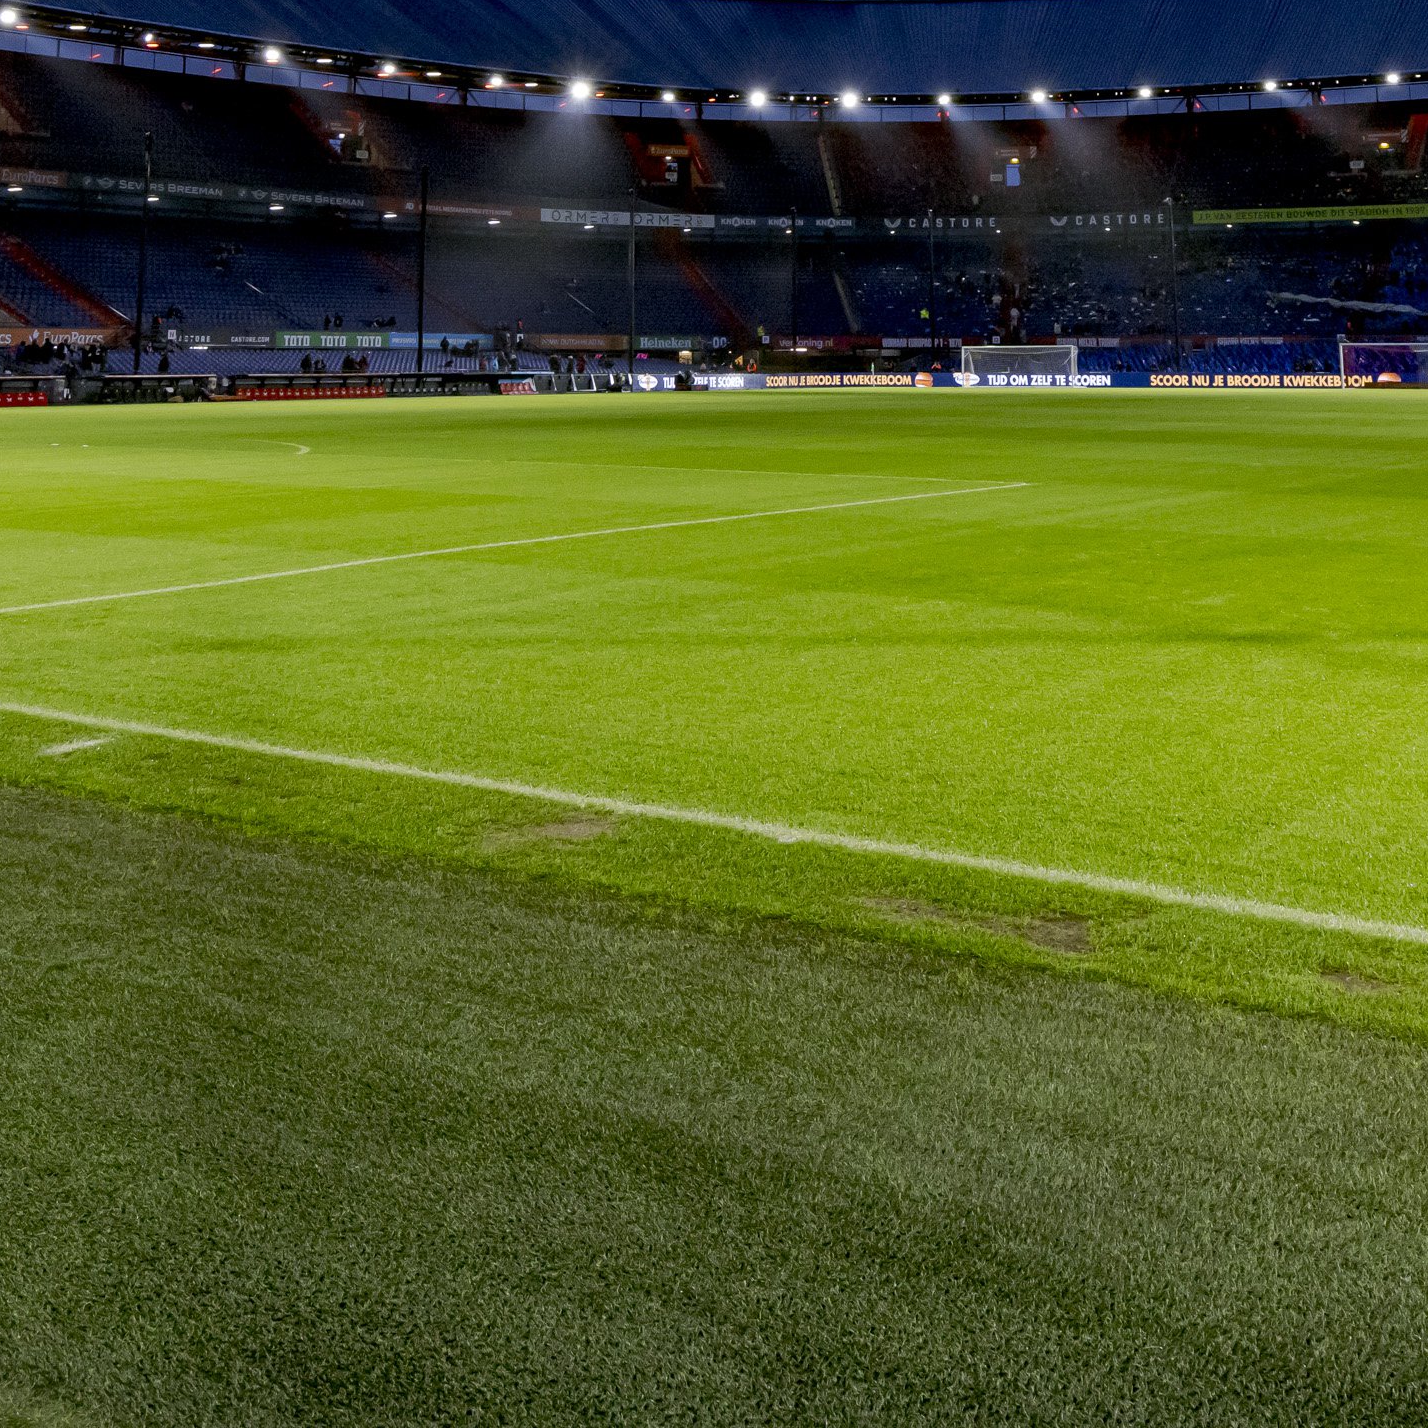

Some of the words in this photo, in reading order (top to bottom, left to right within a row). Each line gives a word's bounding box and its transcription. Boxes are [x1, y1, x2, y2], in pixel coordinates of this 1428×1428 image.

[118, 179, 165, 193] SEVRS
[909, 217, 996, 228] CASTORE
[1075, 213, 1164, 226] CASTORE
[230, 335, 270, 343] CASTORE.COM
[284, 335, 310, 346] TOTO
[320, 335, 347, 347] TOTO
[356, 335, 382, 347] TOTO
[640, 338, 692, 349] Heineken
[709, 376, 717, 388] TE
[717, 376, 744, 388] SCOREN
[765, 375, 788, 387] SCOOR
[788, 375, 798, 387] NU
[799, 375, 806, 387] JE
[806, 374, 841, 386] BROODJE
[843, 374, 912, 386] KWEKKEBOOM
[987, 374, 1008, 386] TIJD
[1009, 374, 1028, 386] OM
[1031, 374, 1053, 386] ZELF
[1055, 375, 1066, 386] TE
[1068, 374, 1111, 386] SCOREN
[1150, 375, 1189, 387] SCOOR
[1191, 375, 1210, 387] NU
[1212, 375, 1224, 387] JE
[1226, 375, 1281, 387] BROODJE
